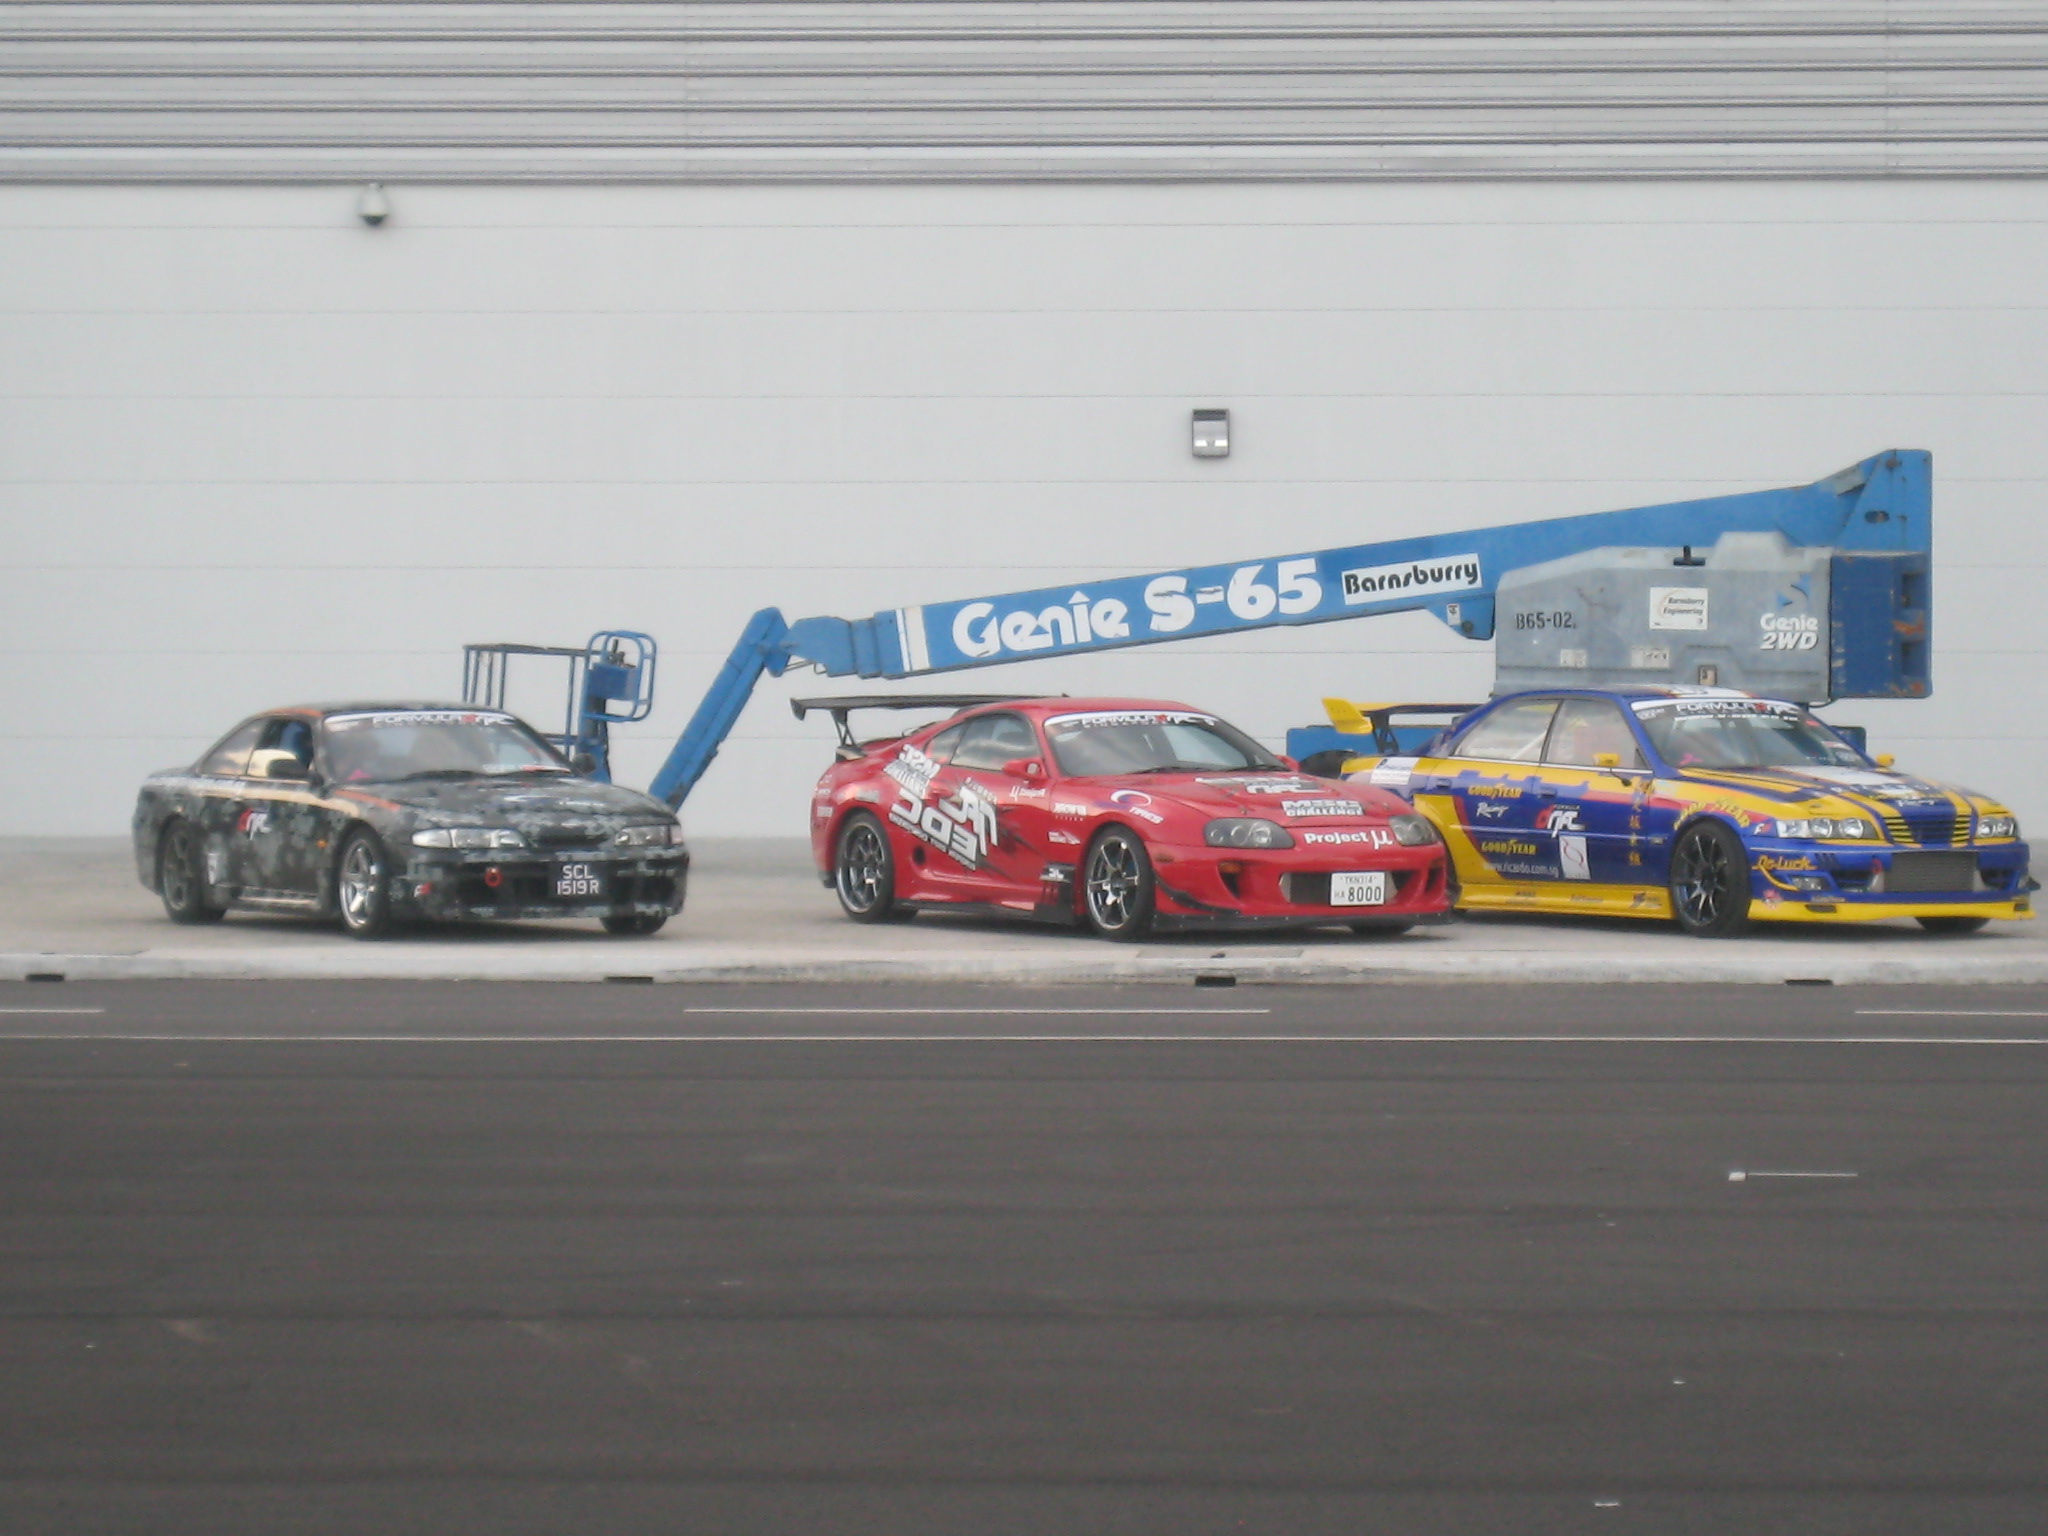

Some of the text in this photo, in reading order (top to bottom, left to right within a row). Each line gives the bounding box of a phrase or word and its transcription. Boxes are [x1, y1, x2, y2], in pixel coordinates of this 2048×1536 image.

[1344, 563, 1479, 596] Barnsburry
[952, 558, 1323, 658] Genie S-65
[1760, 612, 1818, 631] Genie
[1759, 631, 1818, 650] 2WD
[1467, 784, 1523, 799] GOODYEAR
[1304, 830, 1369, 844] Project
[1481, 839, 1537, 855] GOODYEAR
[562, 864, 594, 879] SCL
[1347, 886, 1382, 902] 8000
